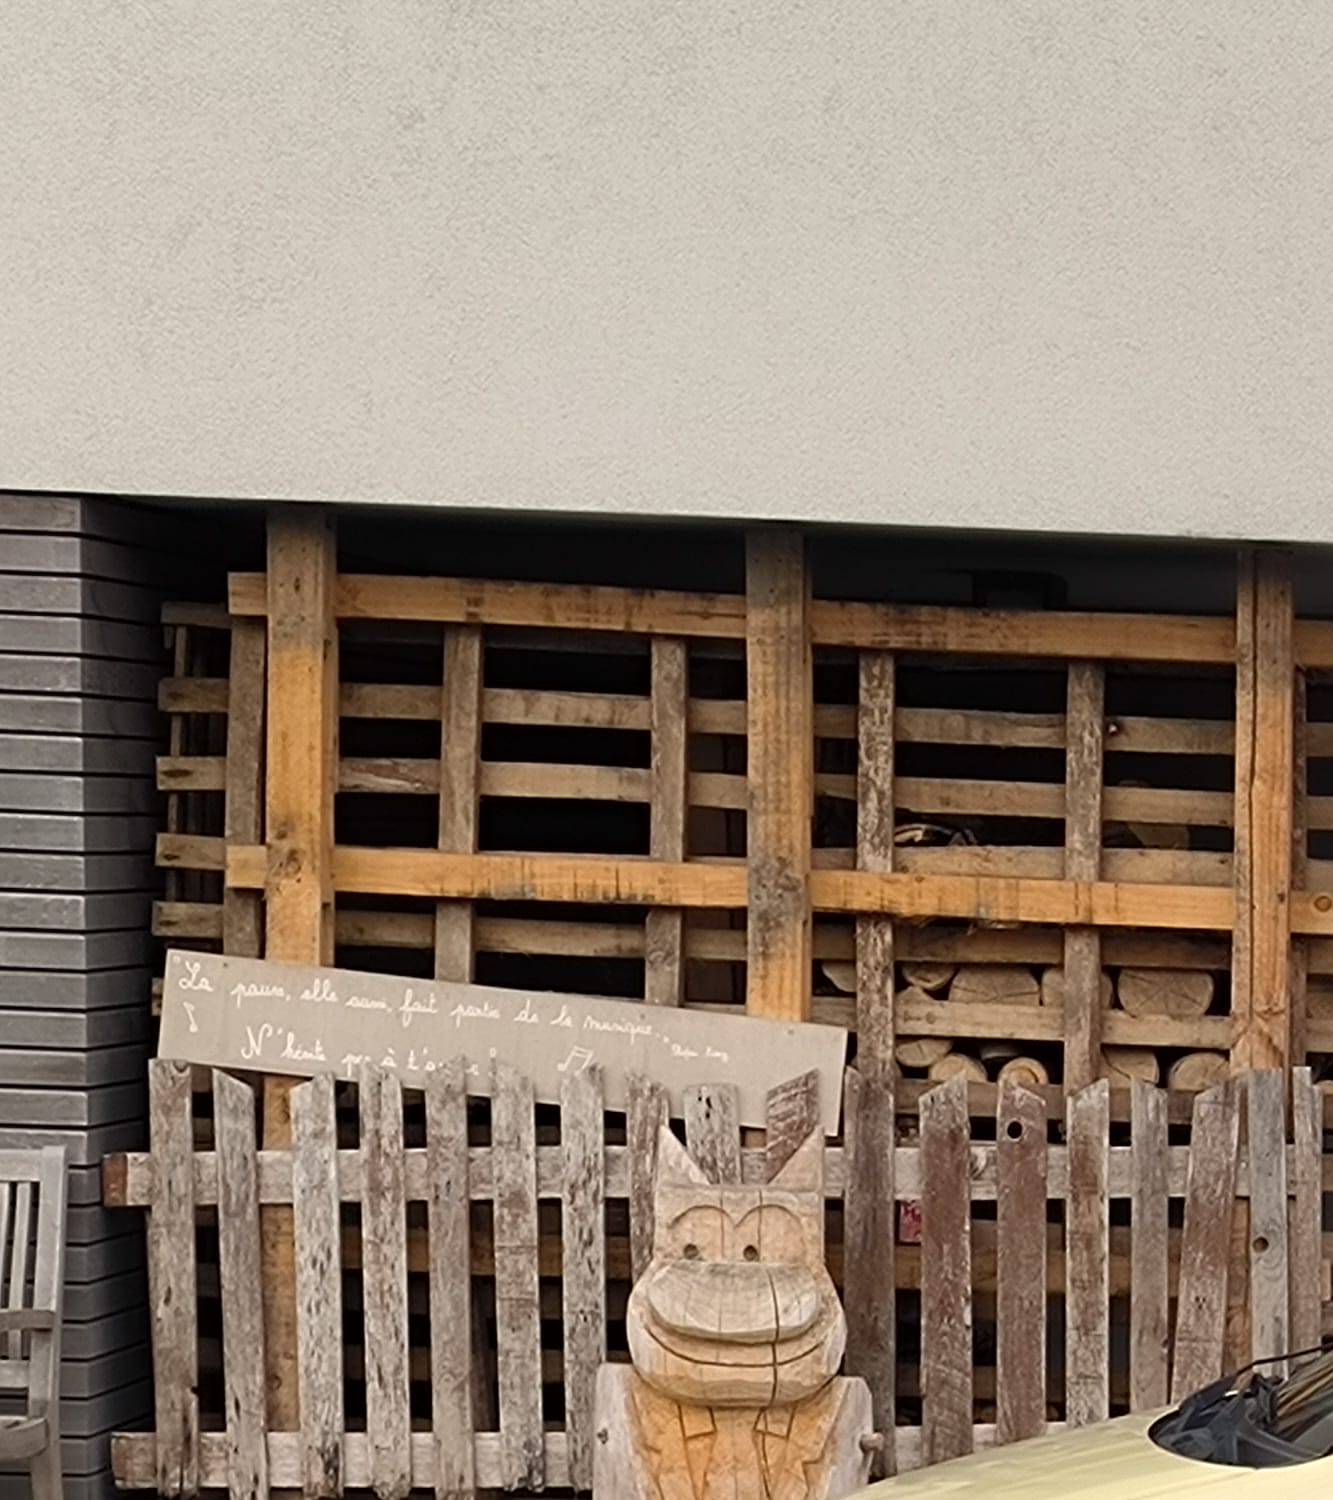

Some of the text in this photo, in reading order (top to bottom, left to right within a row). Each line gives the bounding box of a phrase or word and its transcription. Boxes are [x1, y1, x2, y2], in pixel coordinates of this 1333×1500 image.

[300, 978, 339, 1002] elle
[399, 987, 438, 1028] fait
[514, 998, 539, 1023] de
[550, 1004, 573, 1027] la
[380, 1047, 398, 1067] à
